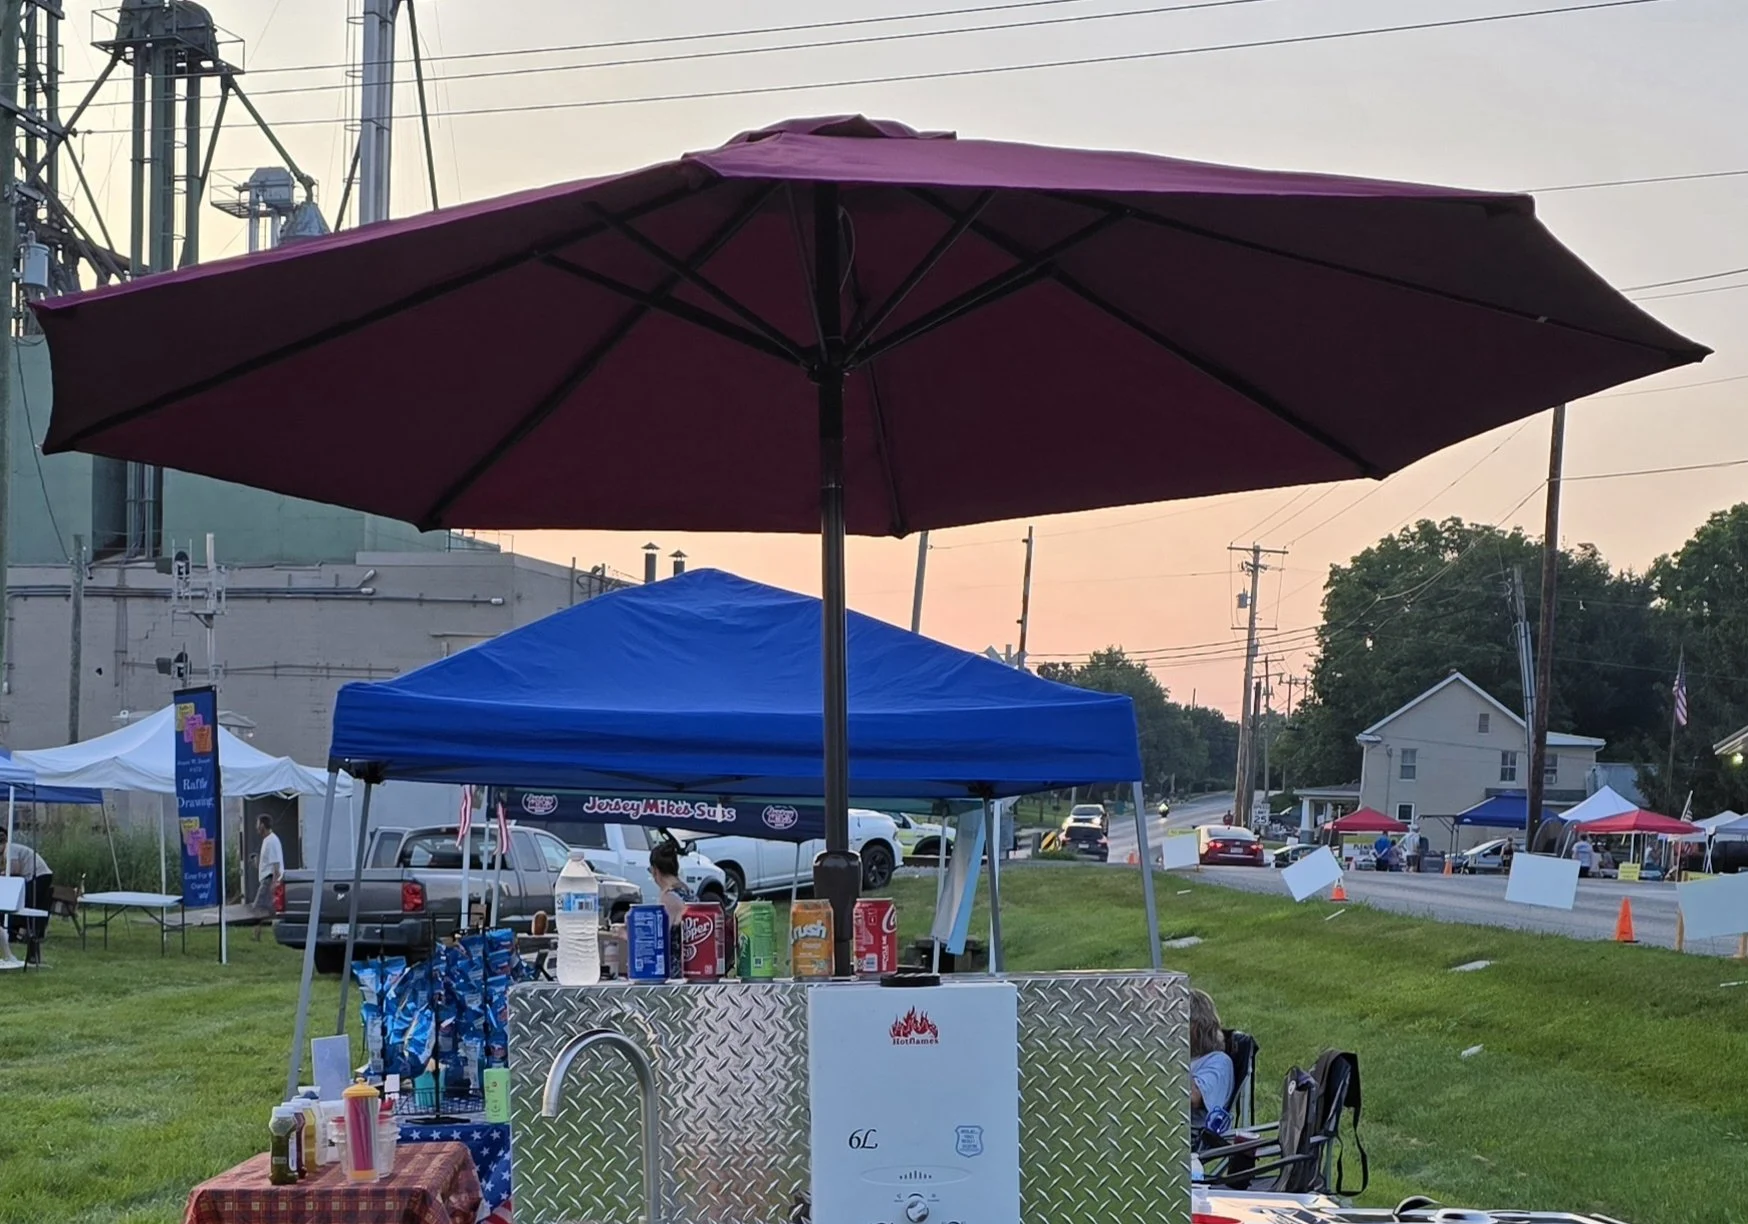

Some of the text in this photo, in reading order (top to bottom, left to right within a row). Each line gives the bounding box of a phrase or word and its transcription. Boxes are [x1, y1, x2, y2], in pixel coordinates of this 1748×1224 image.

[1254, 815, 1267, 824] 25
[682, 922, 710, 943] pper
[685, 917, 699, 932] Dr
[849, 1128, 878, 1150] 6L
